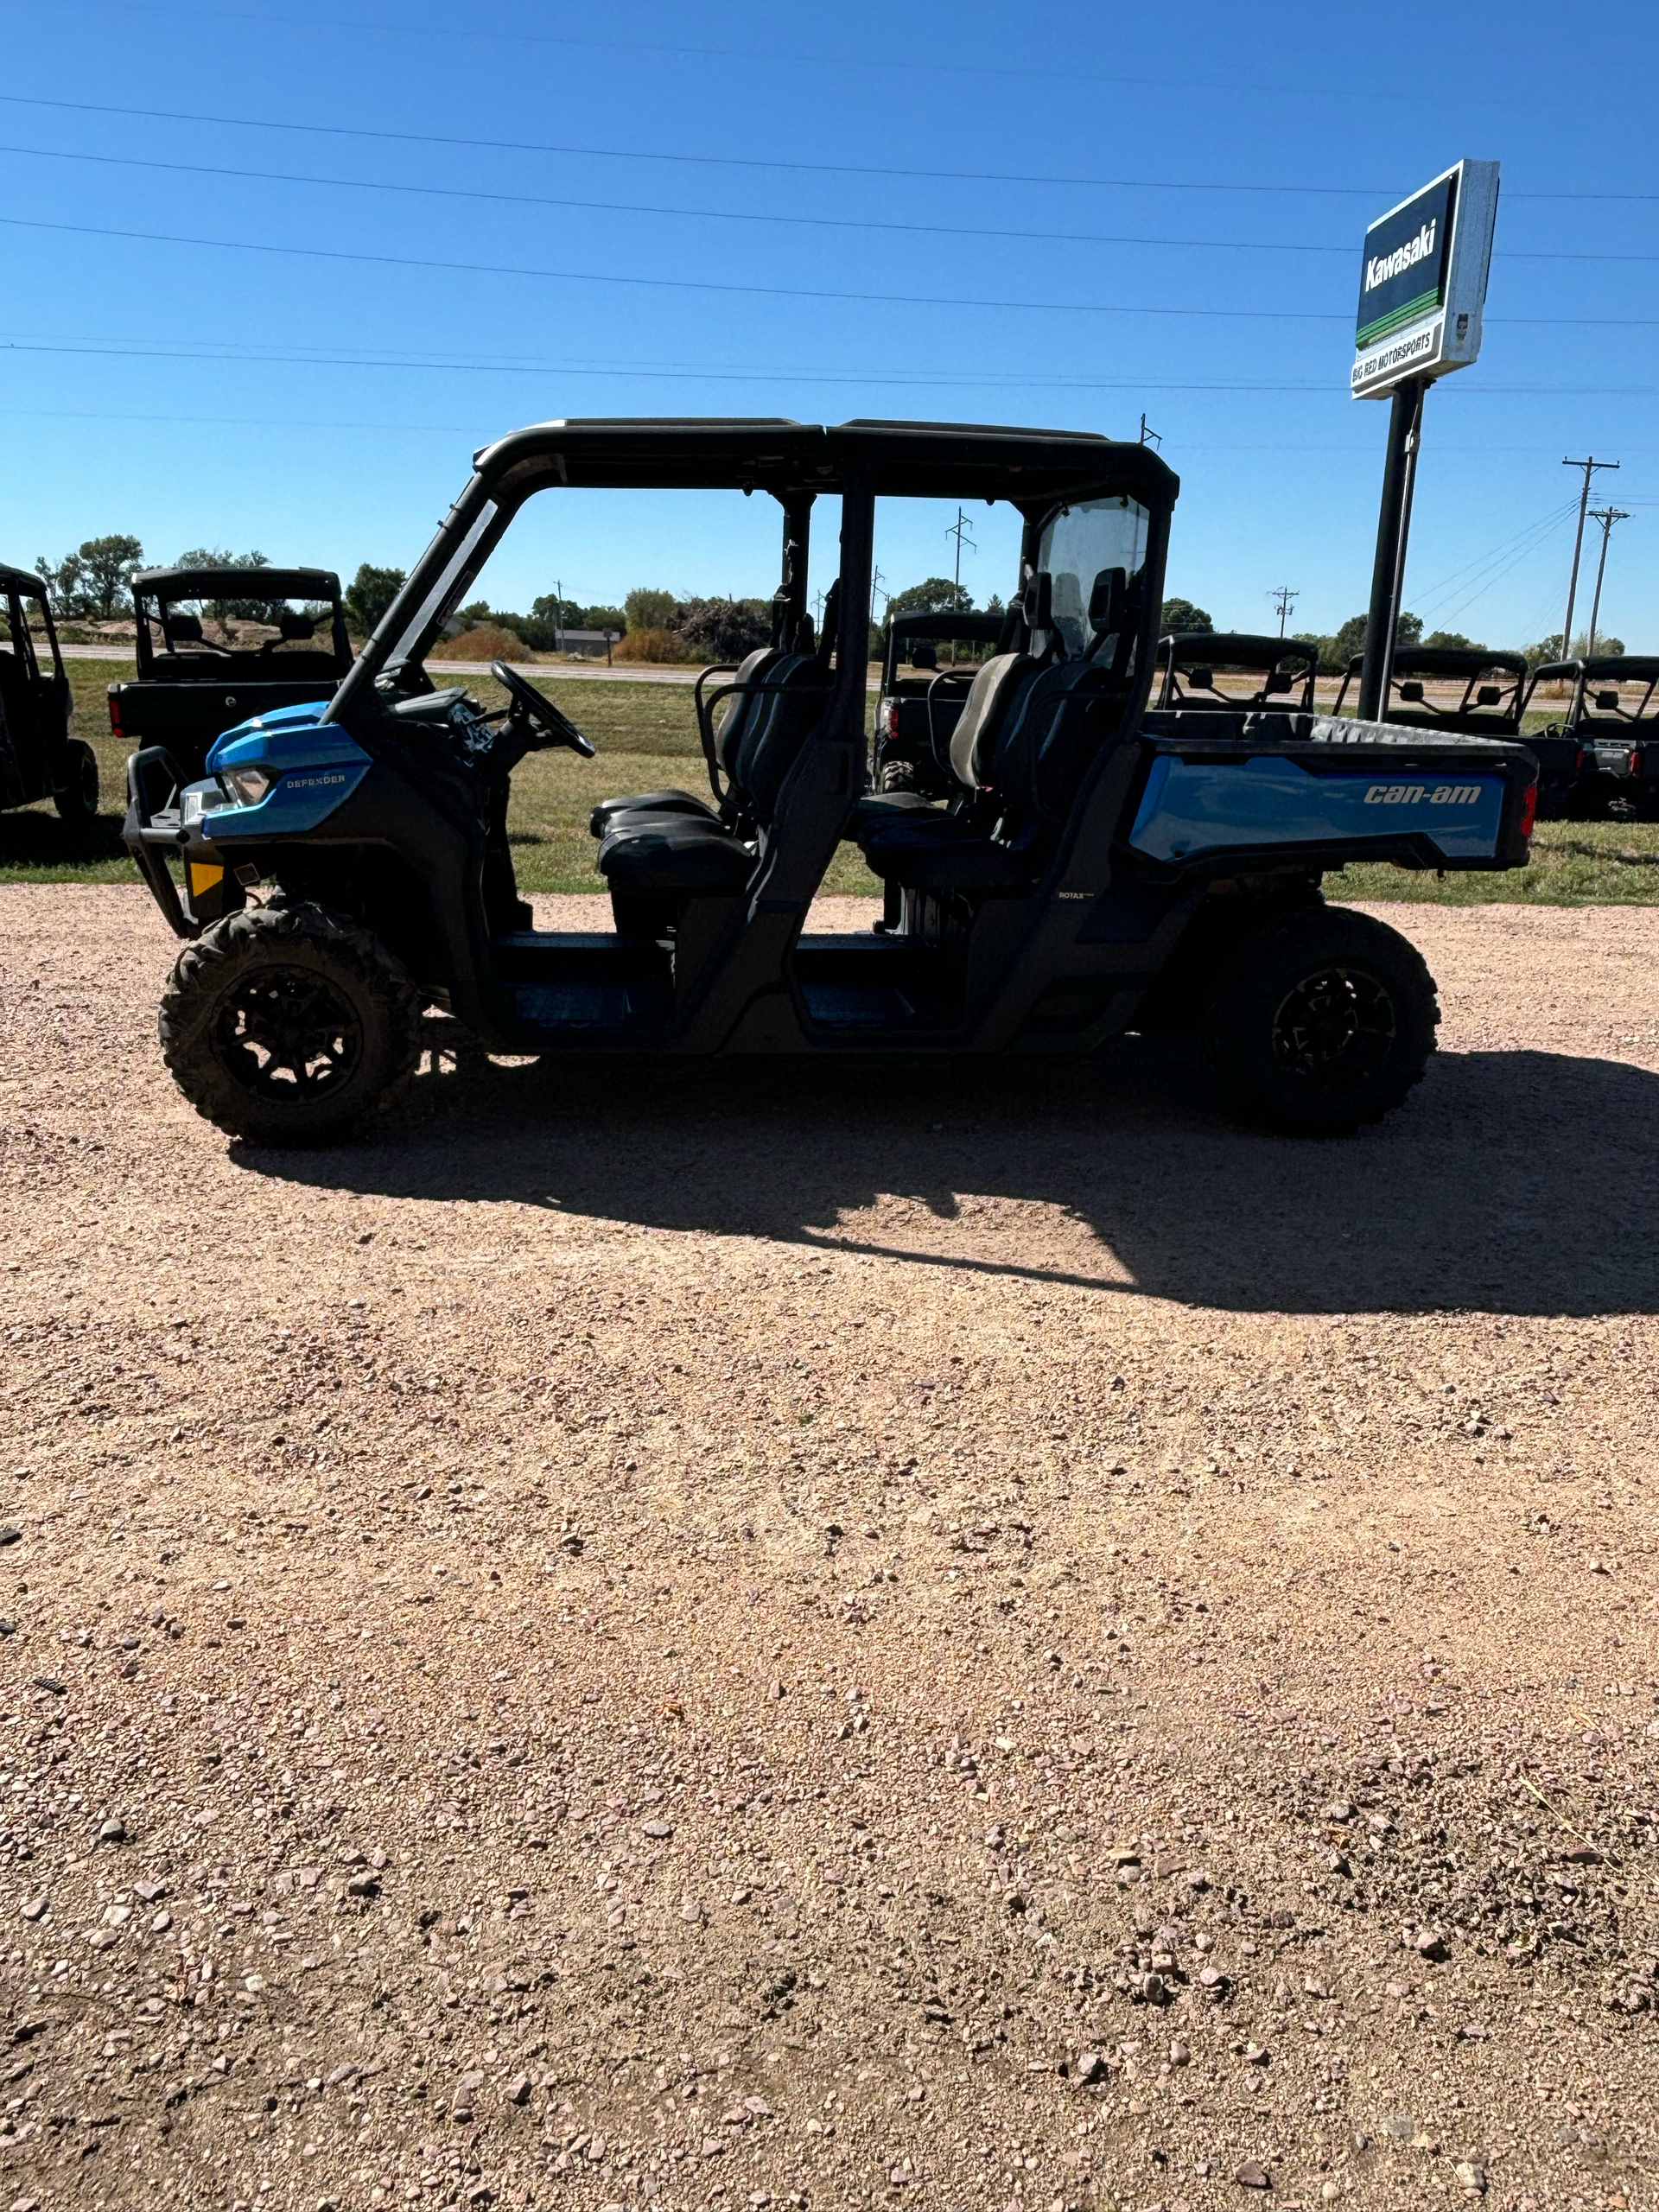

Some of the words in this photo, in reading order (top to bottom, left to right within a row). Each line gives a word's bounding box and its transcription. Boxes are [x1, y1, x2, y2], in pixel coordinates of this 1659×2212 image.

[1365, 218, 1436, 292] Kawasaki
[1363, 358, 1377, 378] RED
[1377, 331, 1431, 371] MOTORSPORTS
[287, 774, 345, 789] DEFENDER
[1363, 785, 1482, 804] can-am
